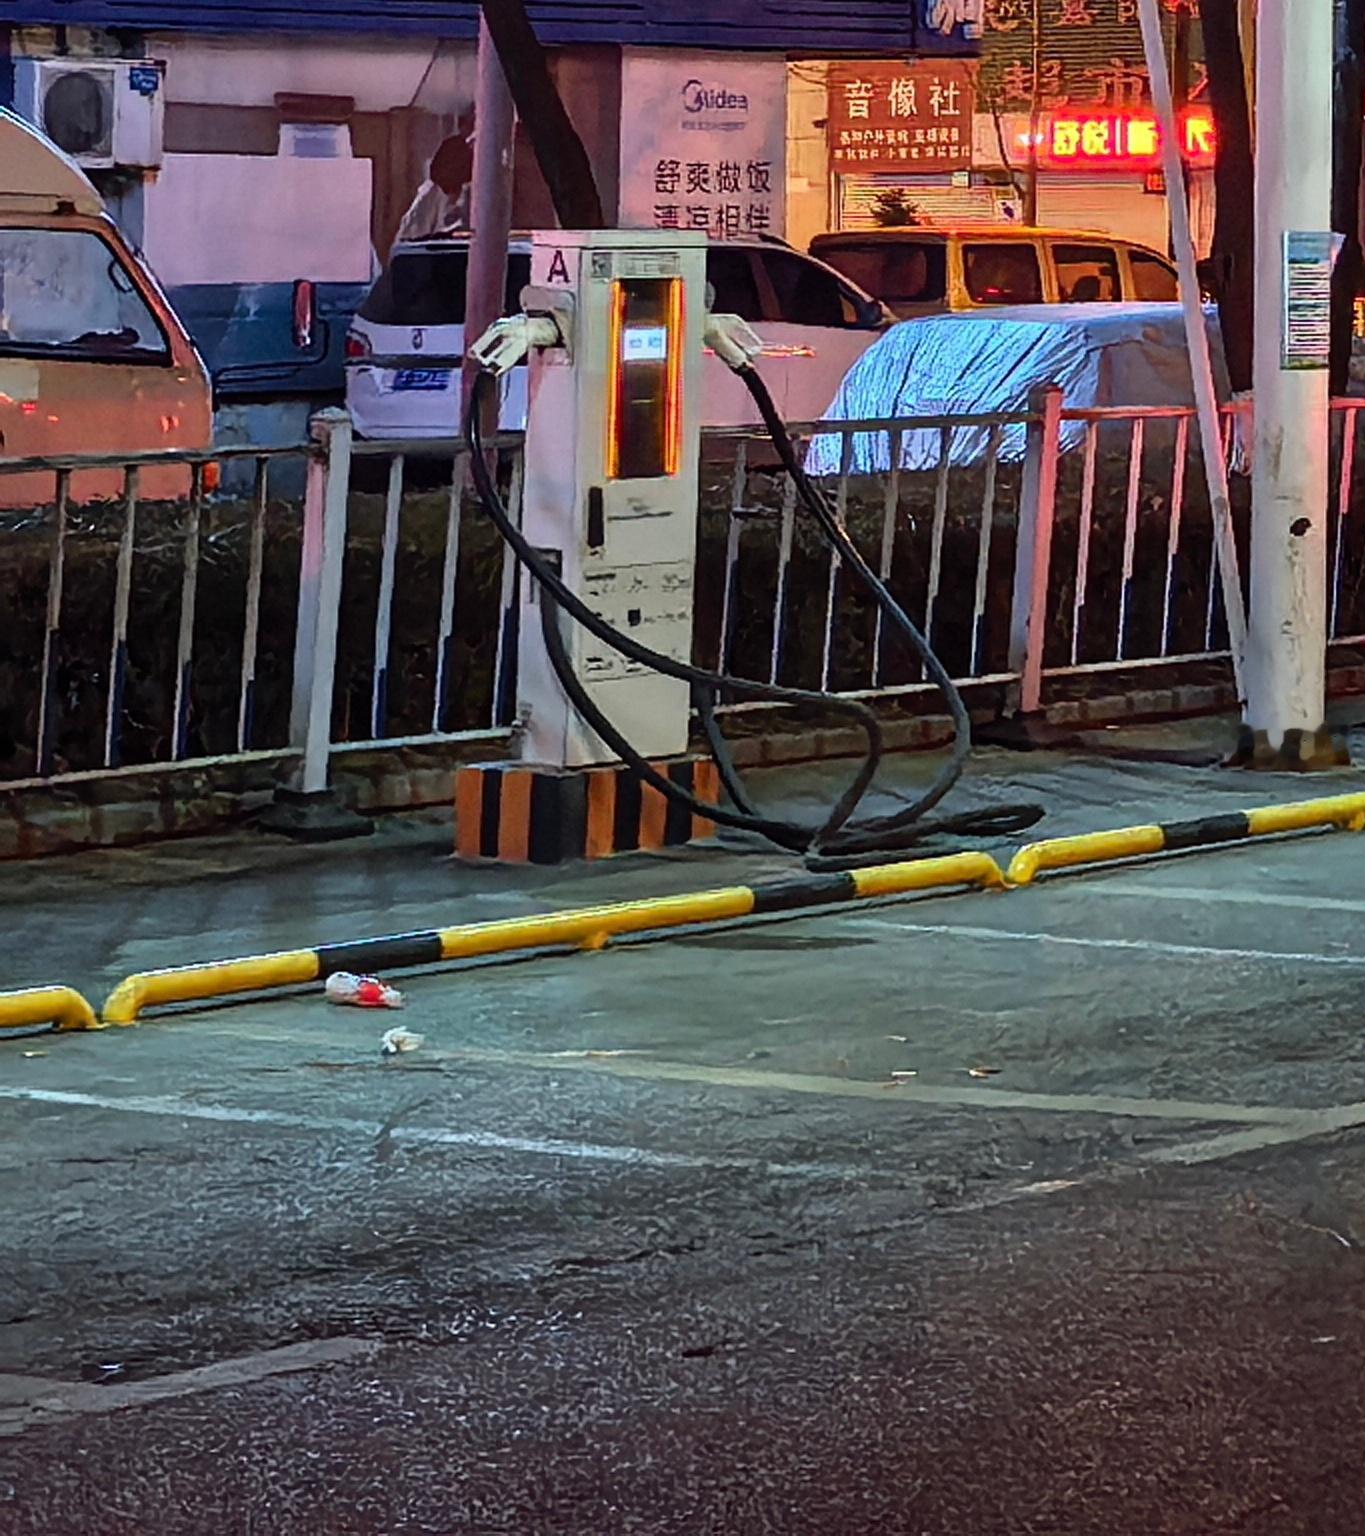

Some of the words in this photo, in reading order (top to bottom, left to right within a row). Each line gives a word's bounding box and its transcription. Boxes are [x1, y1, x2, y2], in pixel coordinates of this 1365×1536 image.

[682, 80, 749, 112] Midea
[844, 77, 961, 119] 音像社
[654, 159, 771, 194] 舒爽做饭
[548, 250, 570, 284] A
